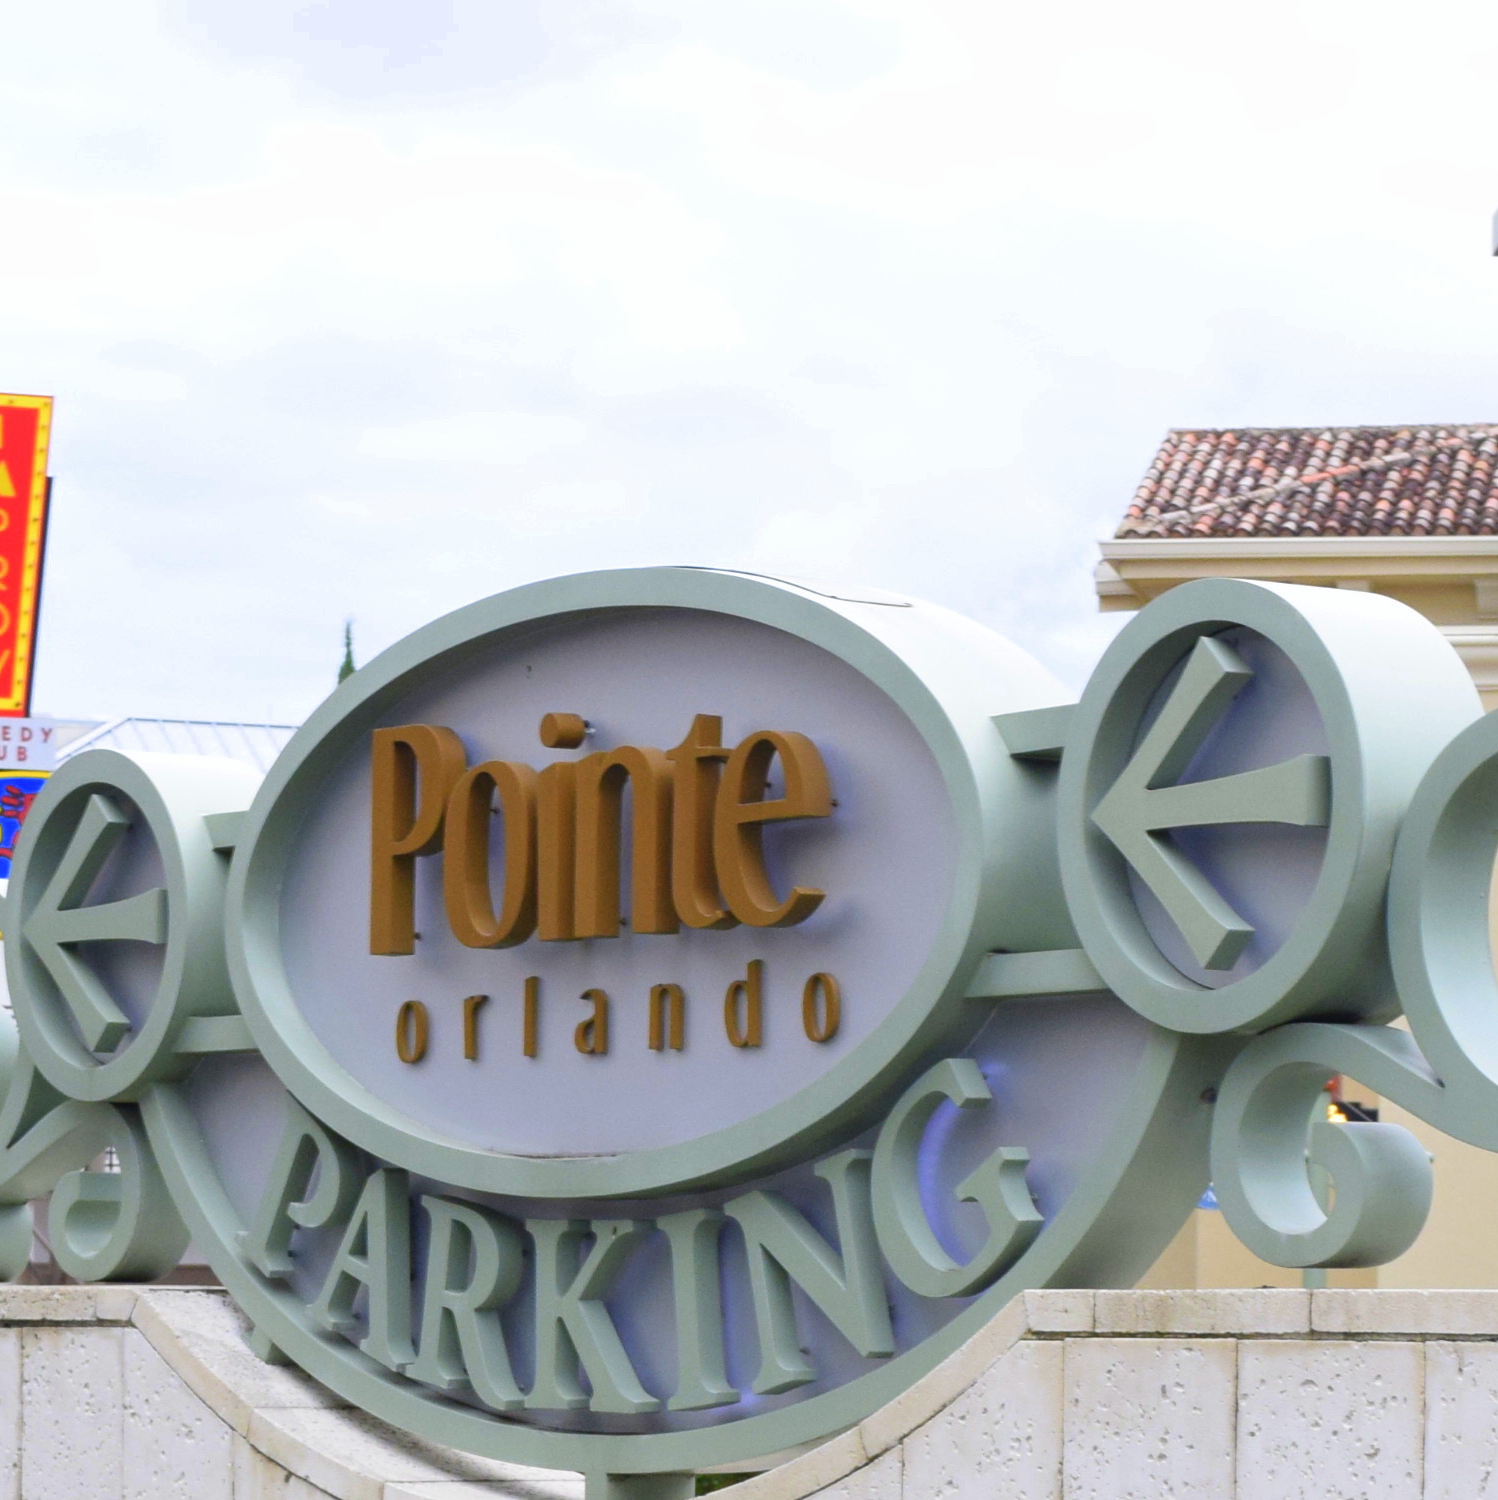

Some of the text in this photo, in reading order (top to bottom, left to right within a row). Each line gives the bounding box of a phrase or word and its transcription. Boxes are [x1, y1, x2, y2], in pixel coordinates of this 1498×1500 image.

[370, 712, 833, 956] Pointe
[395, 959, 842, 1065] orlando
[235, 1058, 1045, 1413] PARKING
